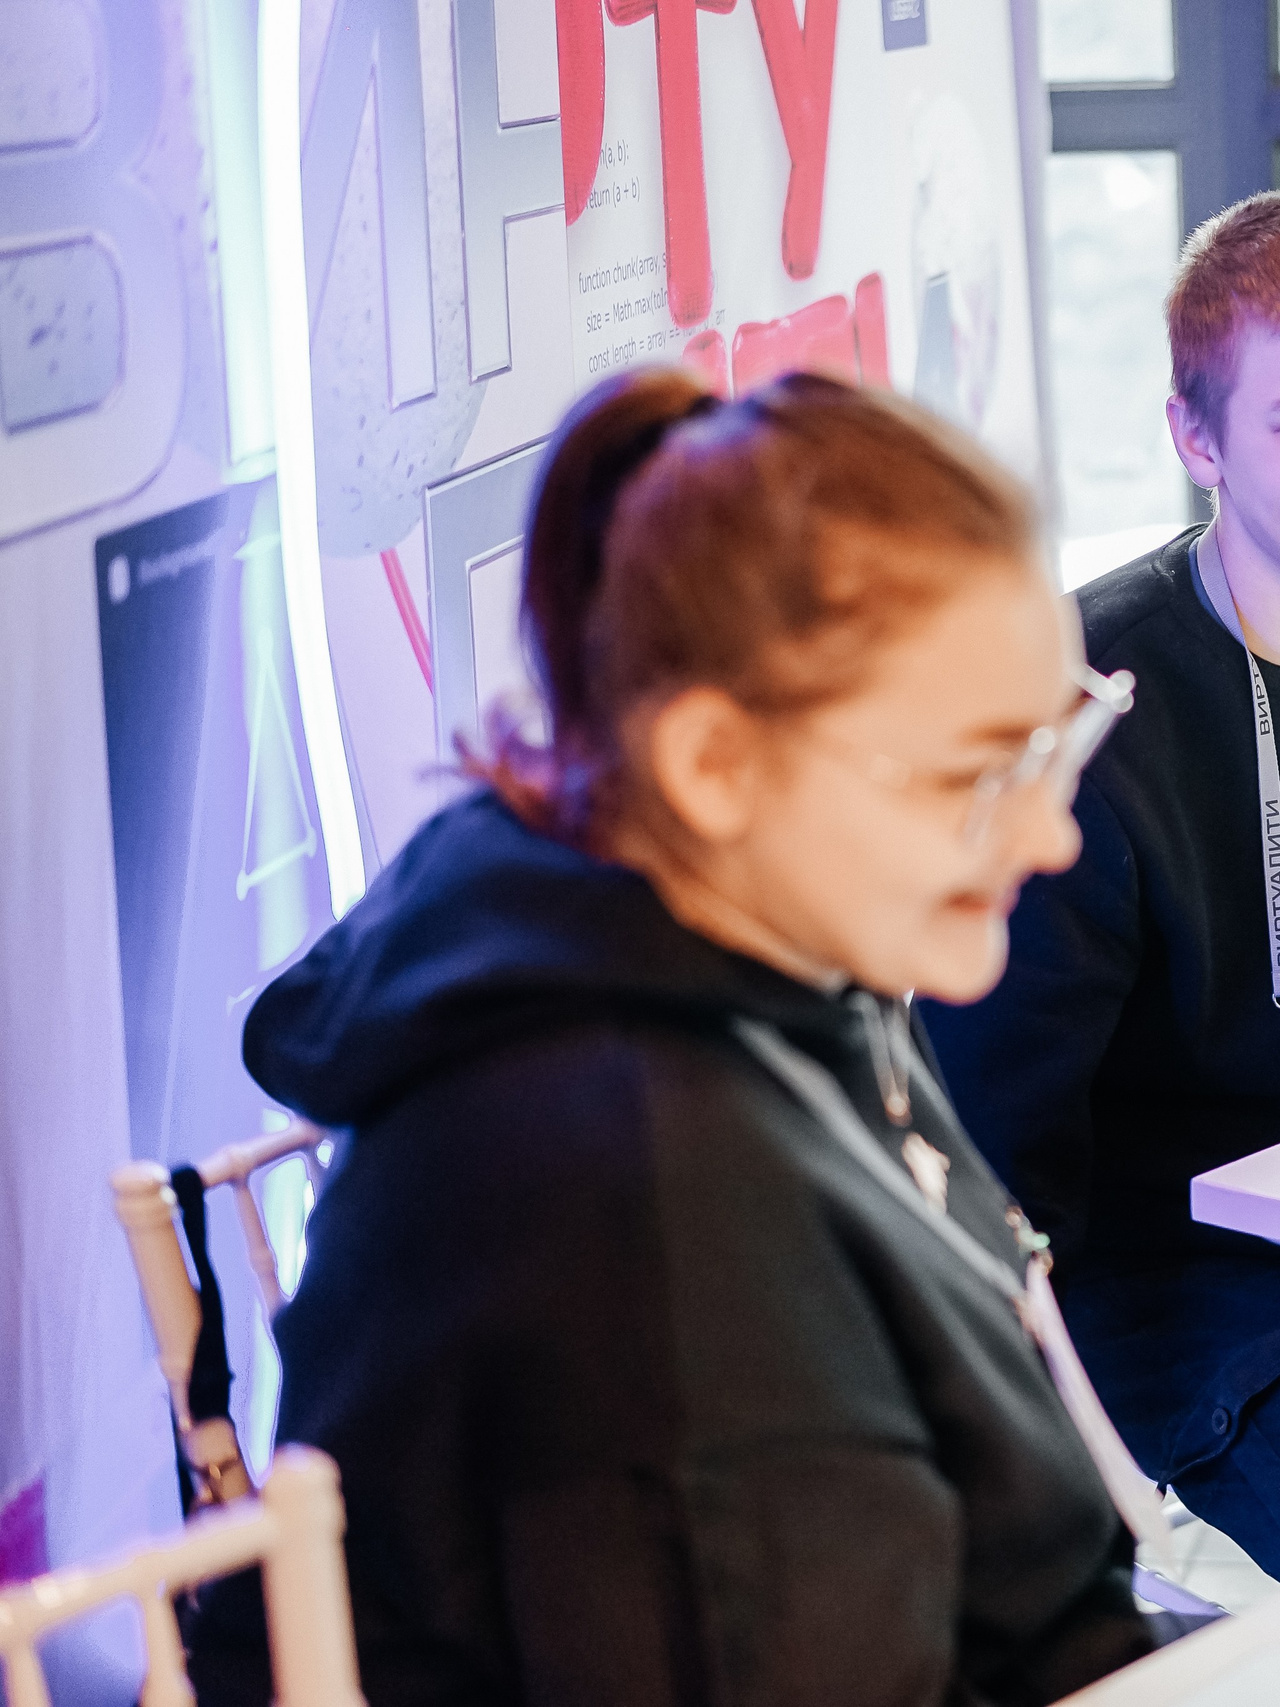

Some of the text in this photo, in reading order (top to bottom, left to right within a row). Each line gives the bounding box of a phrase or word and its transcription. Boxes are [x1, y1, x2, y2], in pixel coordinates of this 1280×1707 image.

[618, 139, 629, 166] b):
[613, 181, 621, 208] (a
[632, 176, 640, 202] b)
[579, 267, 611, 294] function
[613, 254, 660, 284] chunk(array,
[586, 310, 602, 333] size
[588, 346, 610, 373] const
[612, 336, 637, 365] length
[648, 330, 667, 352] array
